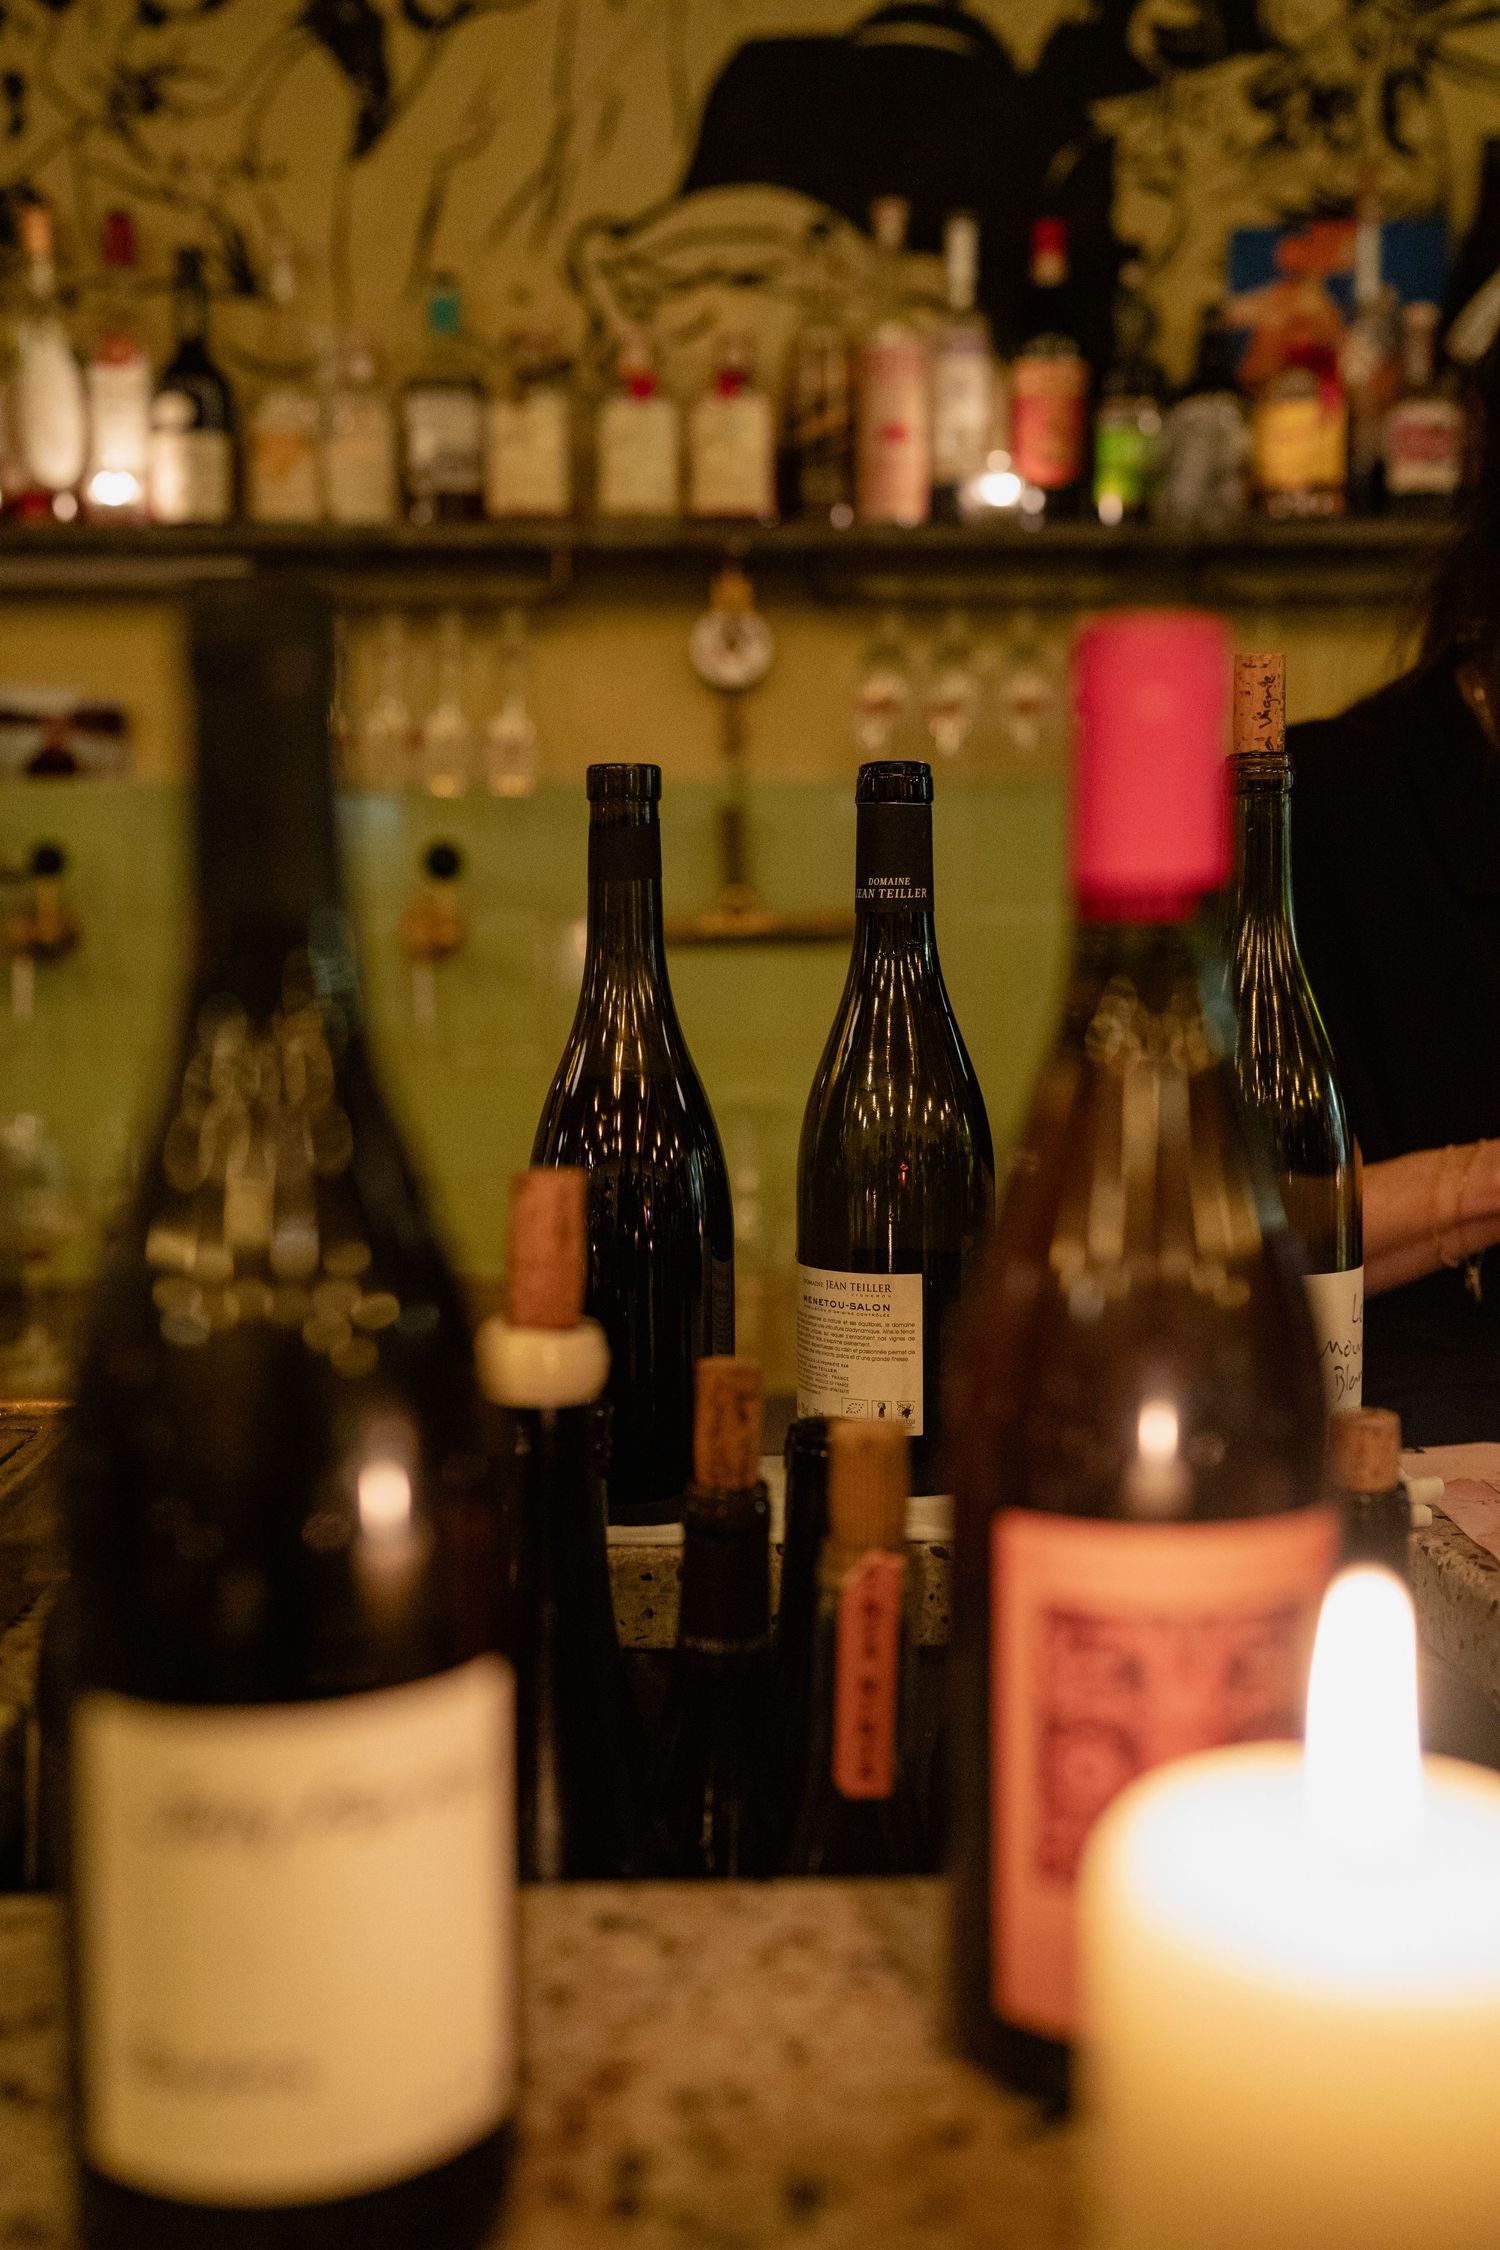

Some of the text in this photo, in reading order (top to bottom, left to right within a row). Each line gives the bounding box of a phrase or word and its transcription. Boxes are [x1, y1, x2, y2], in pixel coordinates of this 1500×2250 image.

[868, 878, 911, 886] DOMAINE
[878, 888, 927, 898] TEILLER
[826, 1280, 847, 1290] JEAN
[850, 1282, 892, 1292] TEILLER
[803, 1295, 890, 1311] MENETOU-SALON
